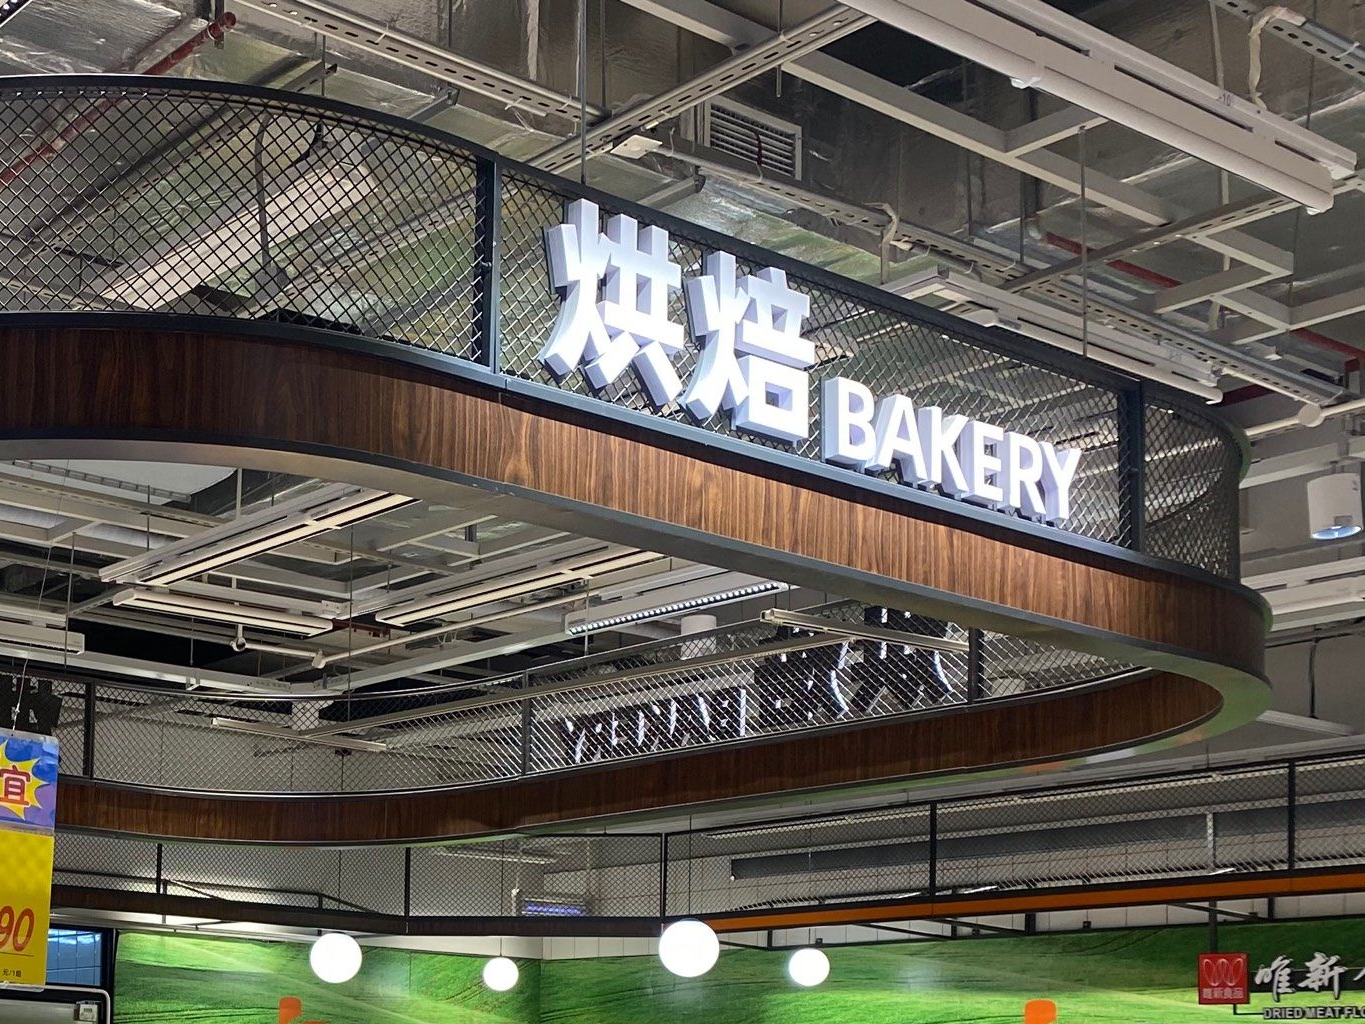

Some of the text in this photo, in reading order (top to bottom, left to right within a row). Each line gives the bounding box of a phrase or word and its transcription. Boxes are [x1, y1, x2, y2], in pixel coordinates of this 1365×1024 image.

[538, 198, 1082, 525] 烘焙 BAKERY
[1264, 1007, 1304, 1020] DRIED
[1306, 1006, 1341, 1019] MEAT
